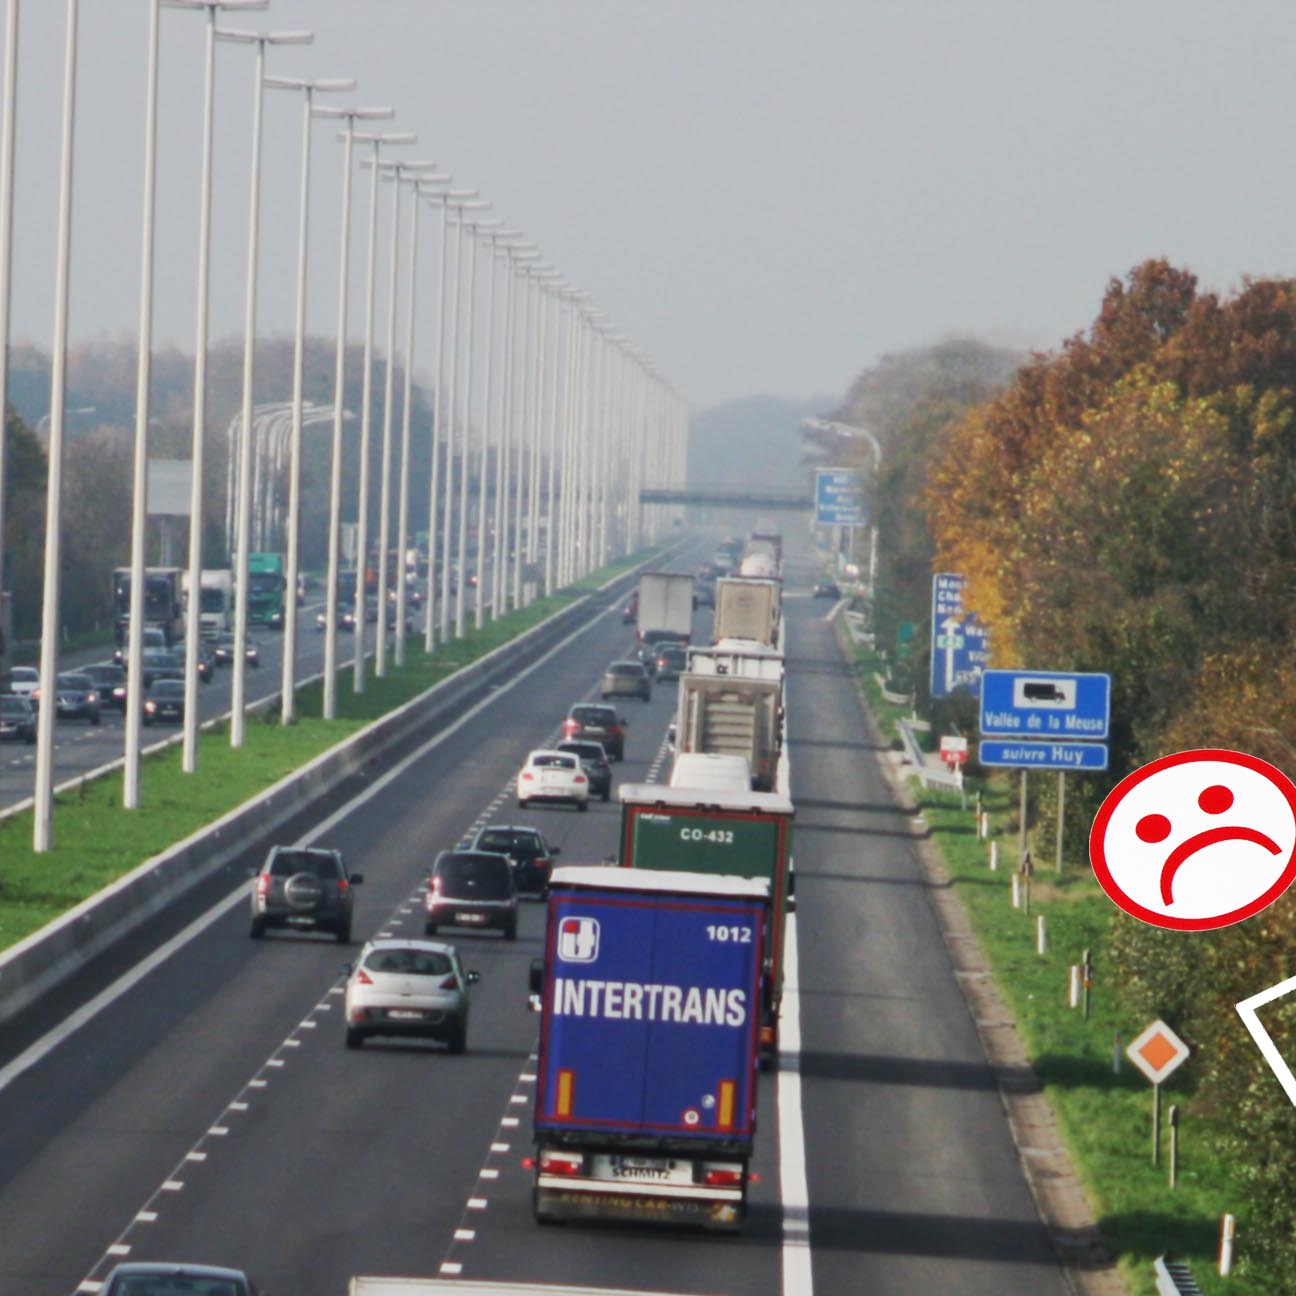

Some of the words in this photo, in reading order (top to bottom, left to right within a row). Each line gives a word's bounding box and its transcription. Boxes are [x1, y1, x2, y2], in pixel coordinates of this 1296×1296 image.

[985, 711, 1021, 728] Vallée
[1027, 713, 1041, 729] de
[1049, 714, 1060, 729] la
[1066, 714, 1104, 731] Meuse
[1002, 747, 1046, 760] suivre
[1052, 746, 1084, 765] Huy
[680, 828, 734, 843] CO-432
[706, 925, 752, 944] 1012
[553, 978, 746, 1027] INTERTRANS
